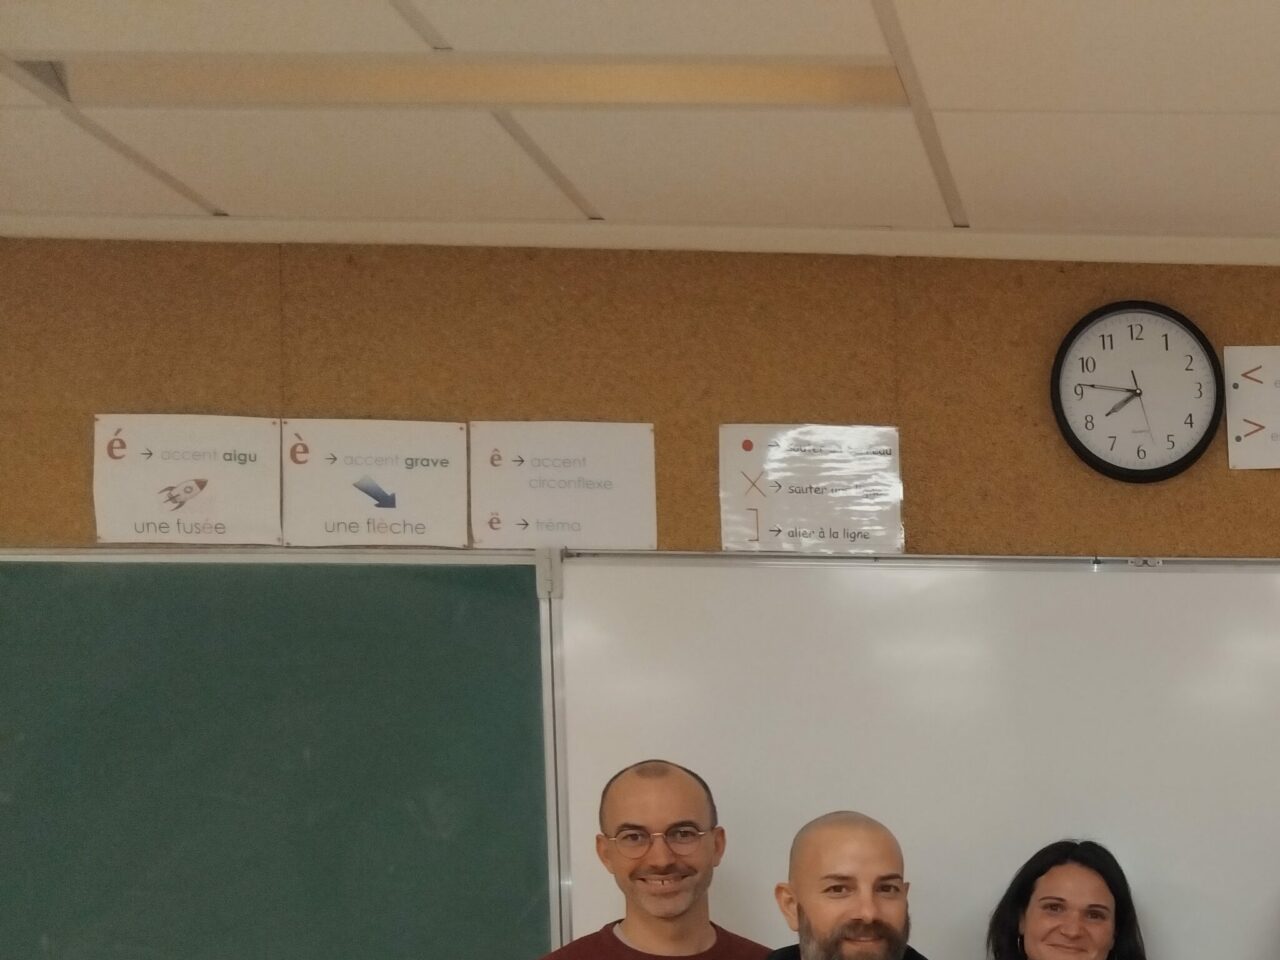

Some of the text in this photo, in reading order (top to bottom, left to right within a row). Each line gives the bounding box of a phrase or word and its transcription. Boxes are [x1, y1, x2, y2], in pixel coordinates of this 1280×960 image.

[1128, 323, 1144, 341] 12
[1099, 333, 1114, 350] 11
[1162, 333, 1169, 351] 1
[1078, 356, 1096, 373] 10
[1184, 355, 1194, 371] 2
[1074, 383, 1084, 401] 9
[1194, 382, 1203, 399] 3
[1084, 415, 1095, 430] 8
[1183, 413, 1194, 429] 4
[106, 428, 127, 460] é
[289, 433, 310, 465] è
[1108, 436, 1117, 451] 7
[1166, 434, 1175, 450] 5
[160, 449, 257, 465] accent aigu
[489, 448, 503, 468] ê
[1136, 444, 1147, 460] 6
[343, 453, 450, 470] accent grave
[529, 456, 587, 469] accent
[528, 477, 614, 491] circonflexe
[788, 484, 827, 495] sauter
[134, 518, 227, 535] une fusée
[324, 518, 426, 535] une flèche
[535, 518, 582, 532] tréma
[818, 527, 825, 540] à
[829, 528, 839, 540] la
[843, 529, 870, 543] ligne
